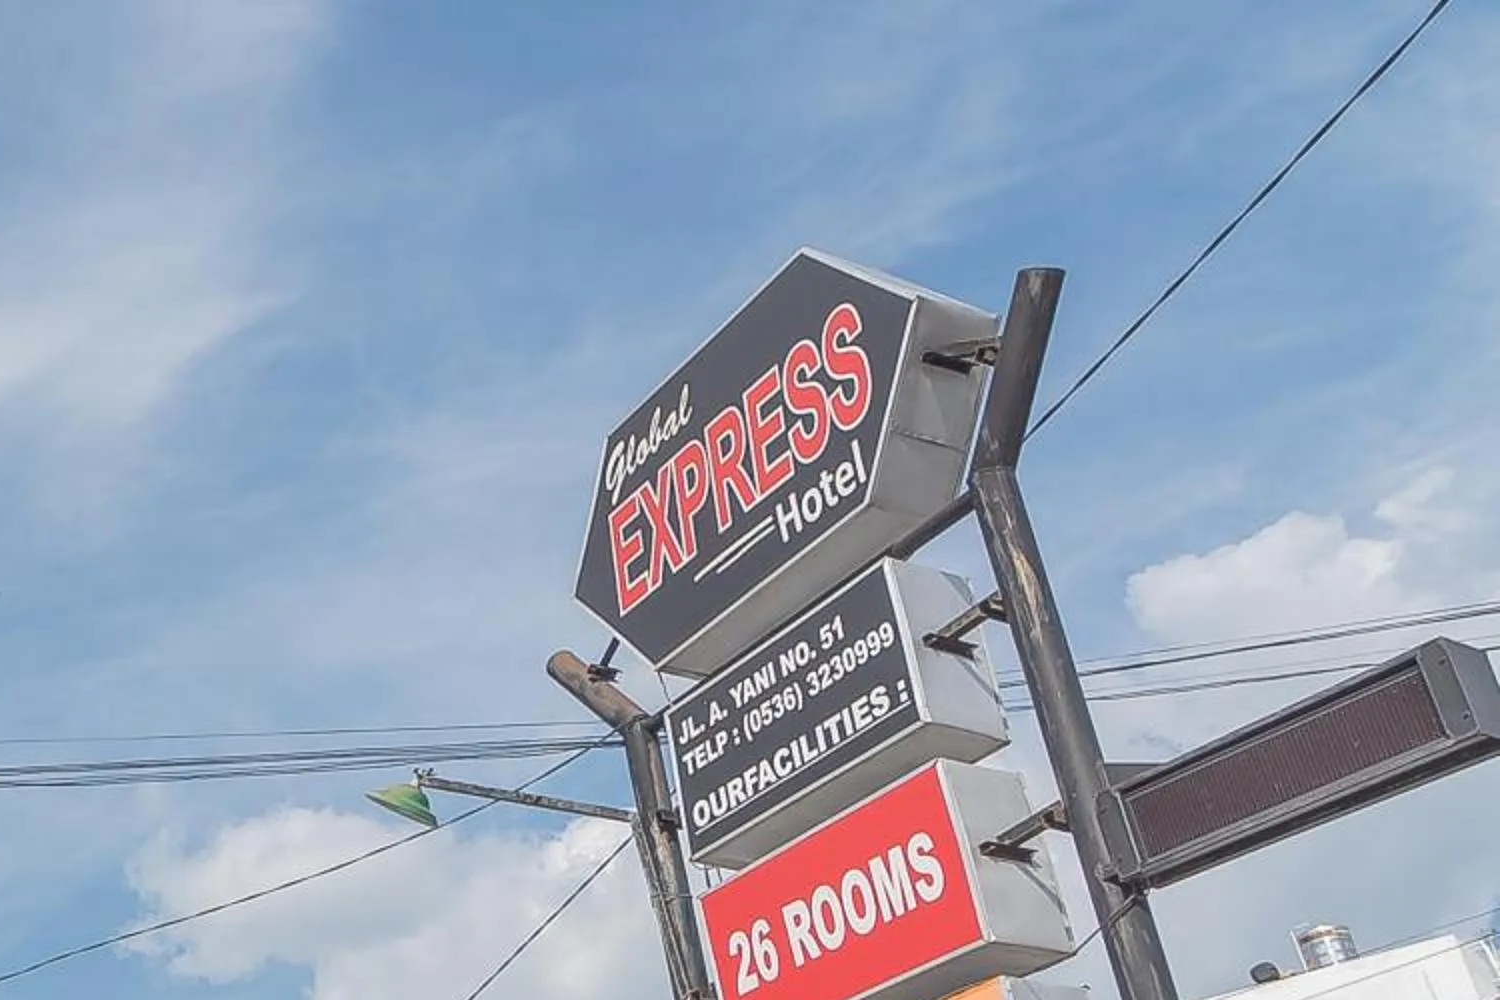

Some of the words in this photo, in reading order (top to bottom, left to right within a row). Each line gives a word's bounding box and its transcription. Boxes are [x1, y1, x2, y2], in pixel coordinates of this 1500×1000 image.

[605, 384, 692, 501] Global
[607, 302, 873, 617] EXPRESS
[775, 440, 867, 542] Hotel
[679, 717, 706, 745] JL.
[708, 701, 728, 726] A.
[729, 661, 777, 710] YANI
[779, 641, 817, 677] NO.
[819, 615, 845, 648] 51
[681, 730, 728, 775] TELP
[743, 682, 803, 741] (0536)
[806, 621, 895, 697] 3230999
[692, 685, 891, 828] OURFACILITIES
[728, 917, 780, 997] 26
[781, 832, 946, 967] ROOMS
